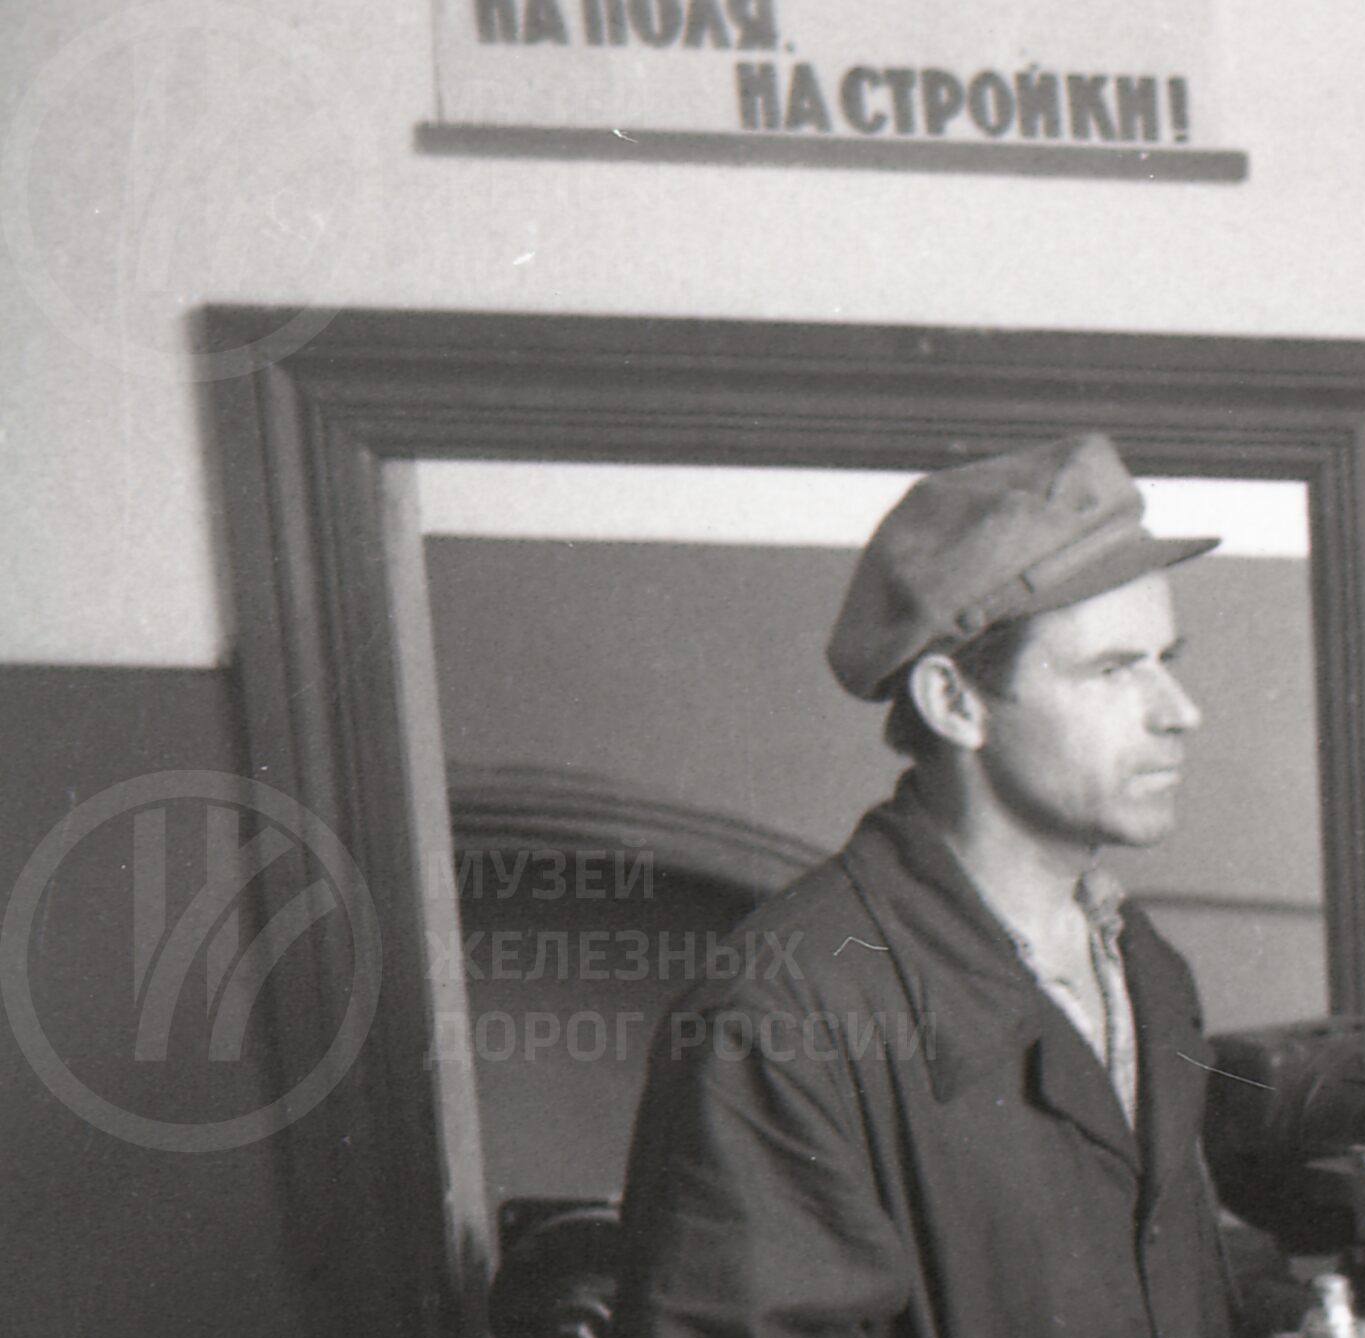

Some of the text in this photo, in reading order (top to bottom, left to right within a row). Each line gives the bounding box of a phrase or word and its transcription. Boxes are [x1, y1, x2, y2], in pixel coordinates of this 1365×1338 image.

[474, 0, 569, 46] НА
[734, 61, 833, 132] НА
[839, 62, 1190, 143] СТРОЙКИ!
